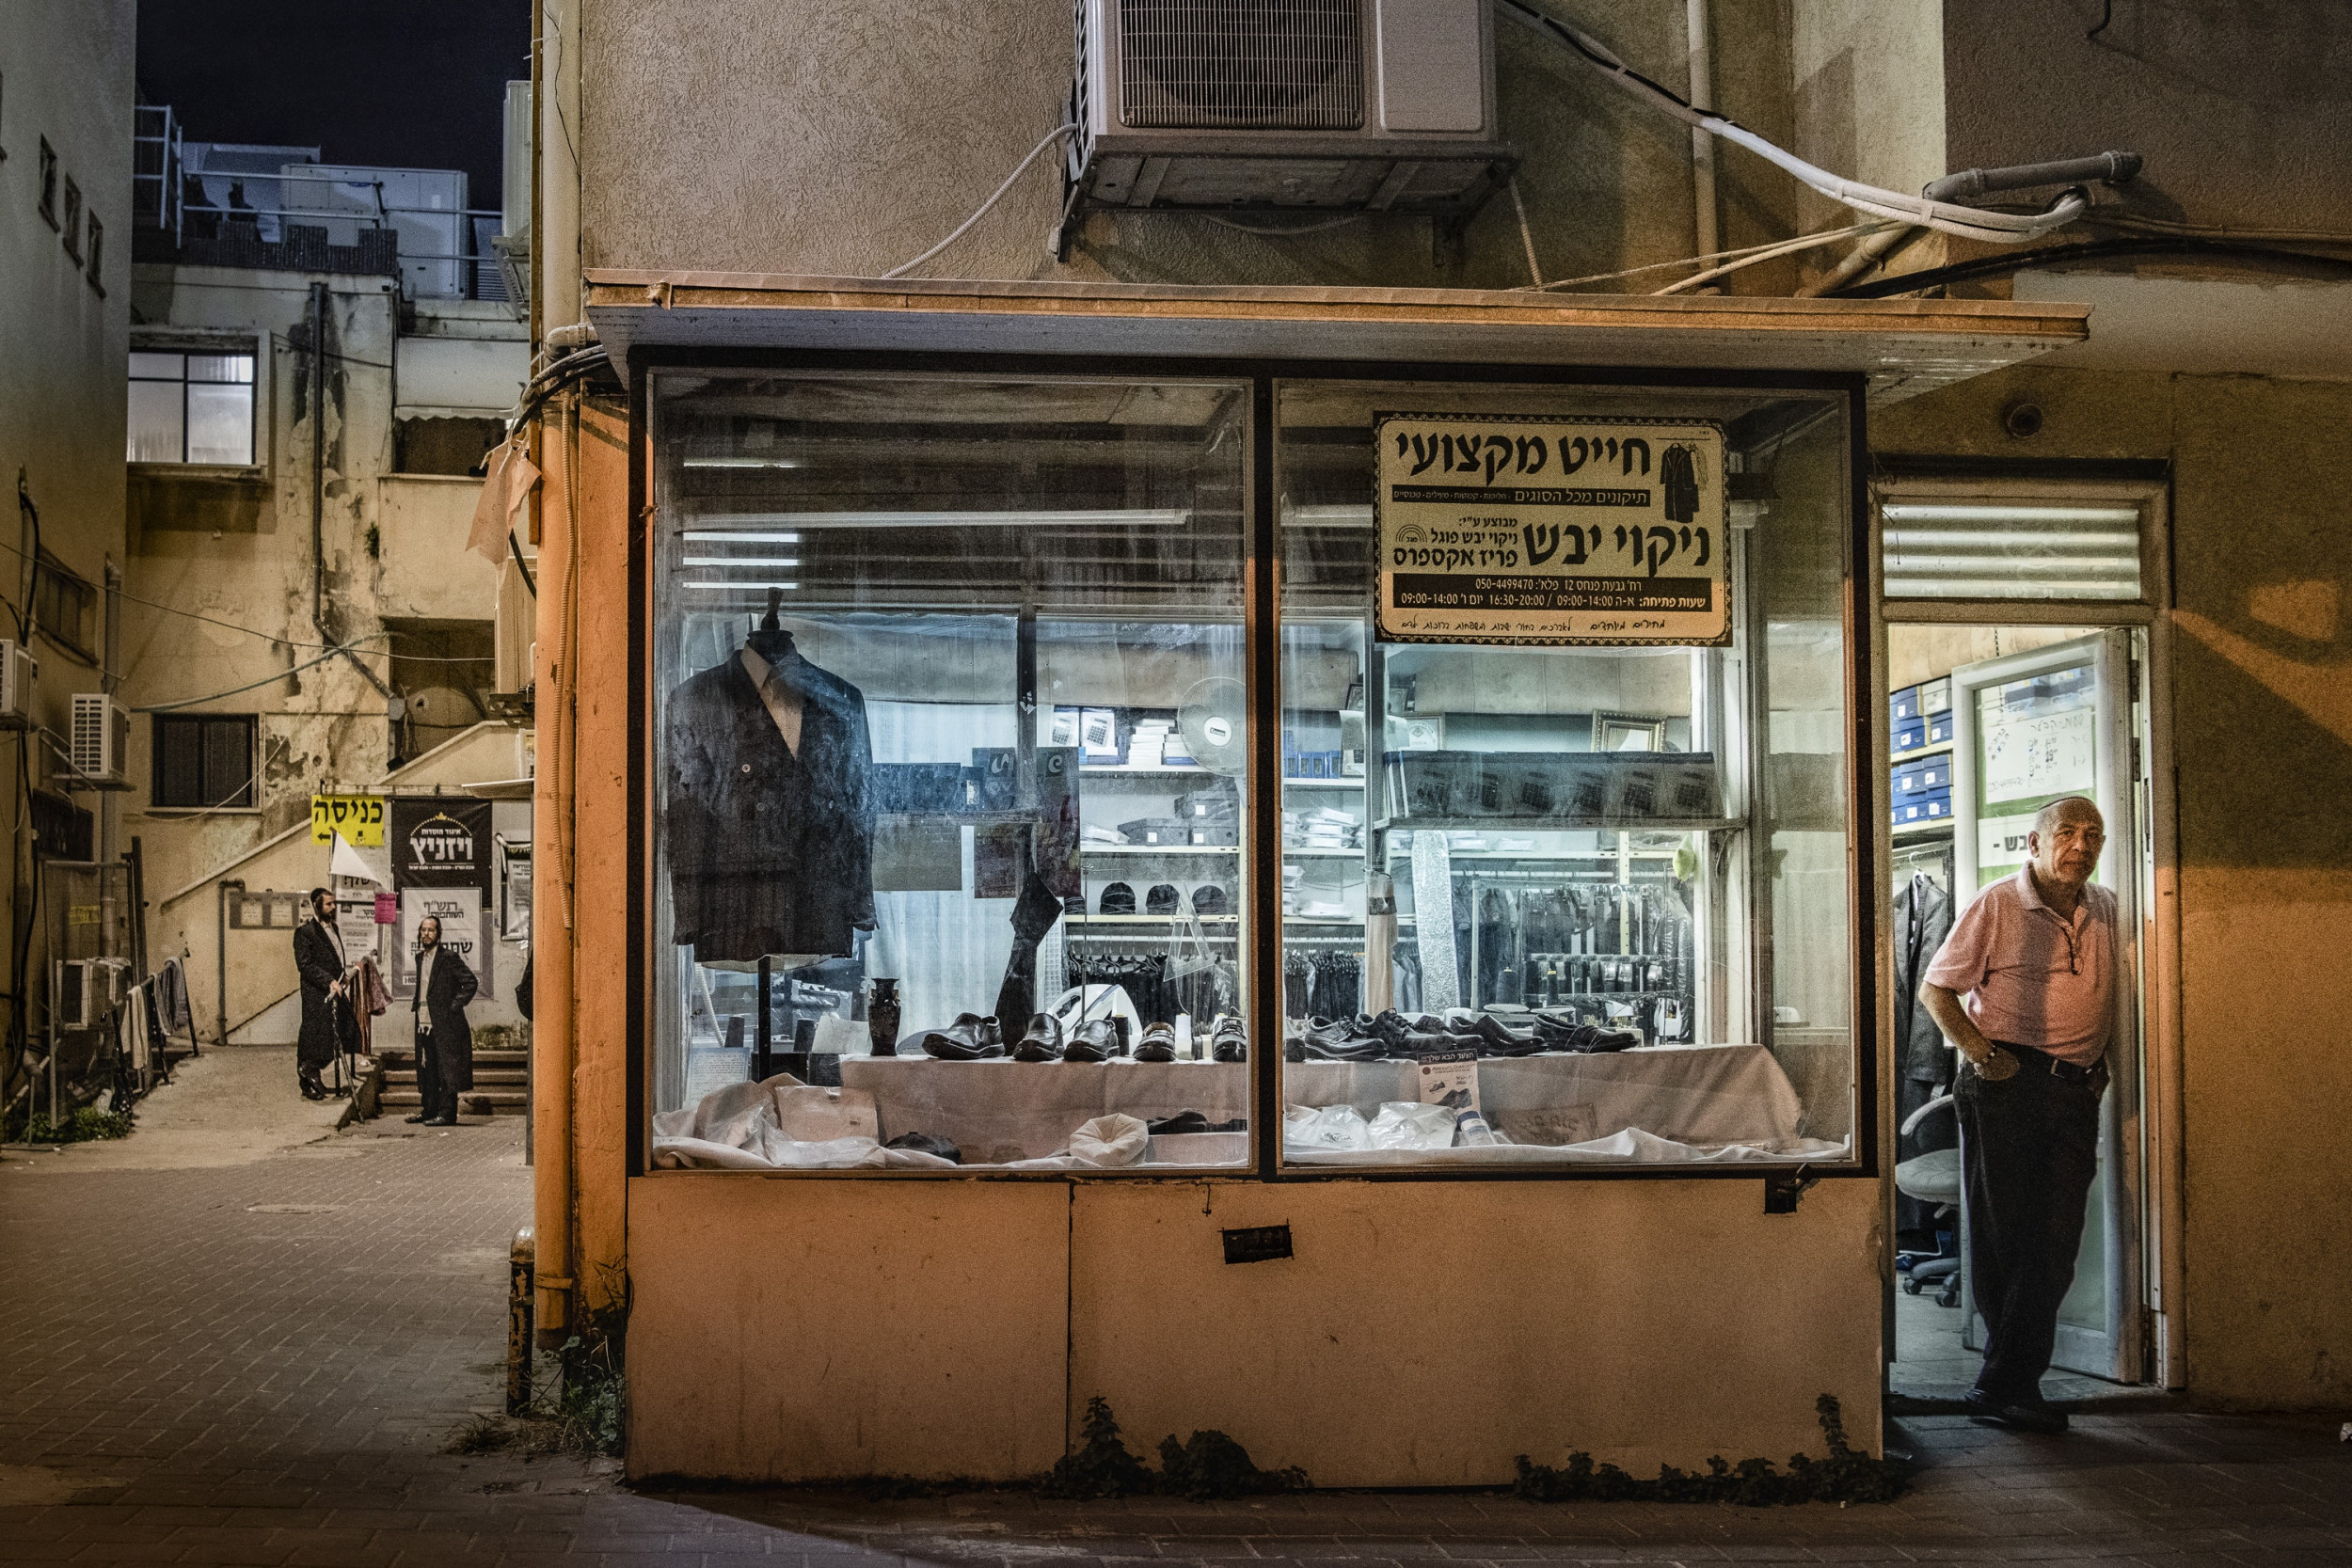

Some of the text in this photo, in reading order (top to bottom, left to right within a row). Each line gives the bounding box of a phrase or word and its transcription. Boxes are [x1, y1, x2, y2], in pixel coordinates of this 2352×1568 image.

[1395, 433, 1650, 486] חייט מקצועי
[1515, 490, 1562, 503] הסוגים
[1565, 489, 1592, 503] מכל
[1597, 492, 1646, 506] תיקונים
[1483, 517, 1518, 527] מבוצע
[1431, 528, 1518, 547] ניקוי יבש פוגל
[1522, 523, 1709, 578] ניקוי יבש
[1393, 547, 1518, 572] פריז אקספרס
[1475, 578, 1534, 590] 050-4499470
[1565, 579, 1574, 591] 12
[1576, 580, 1599, 591] פנחס
[1601, 580, 1626, 591] גבעת
[1628, 580, 1642, 591] רח'
[1401, 593, 1458, 604] 09:00-14:00
[1470, 594, 1484, 605] יום
[1490, 594, 1545, 606] 16:30-20:00
[1557, 594, 1613, 607] 09:00-14:00
[1615, 594, 1635, 606] א-ה
[1639, 597, 1676, 608] פתיחה:
[1678, 597, 1706, 608] שעות
[1590, 621, 1626, 631] מיוחדים
[1632, 619, 1665, 629] מחירים
[313, 800, 384, 824] כניסה
[2004, 835, 2027, 852] בש
[410, 837, 473, 865] ויזניץ
